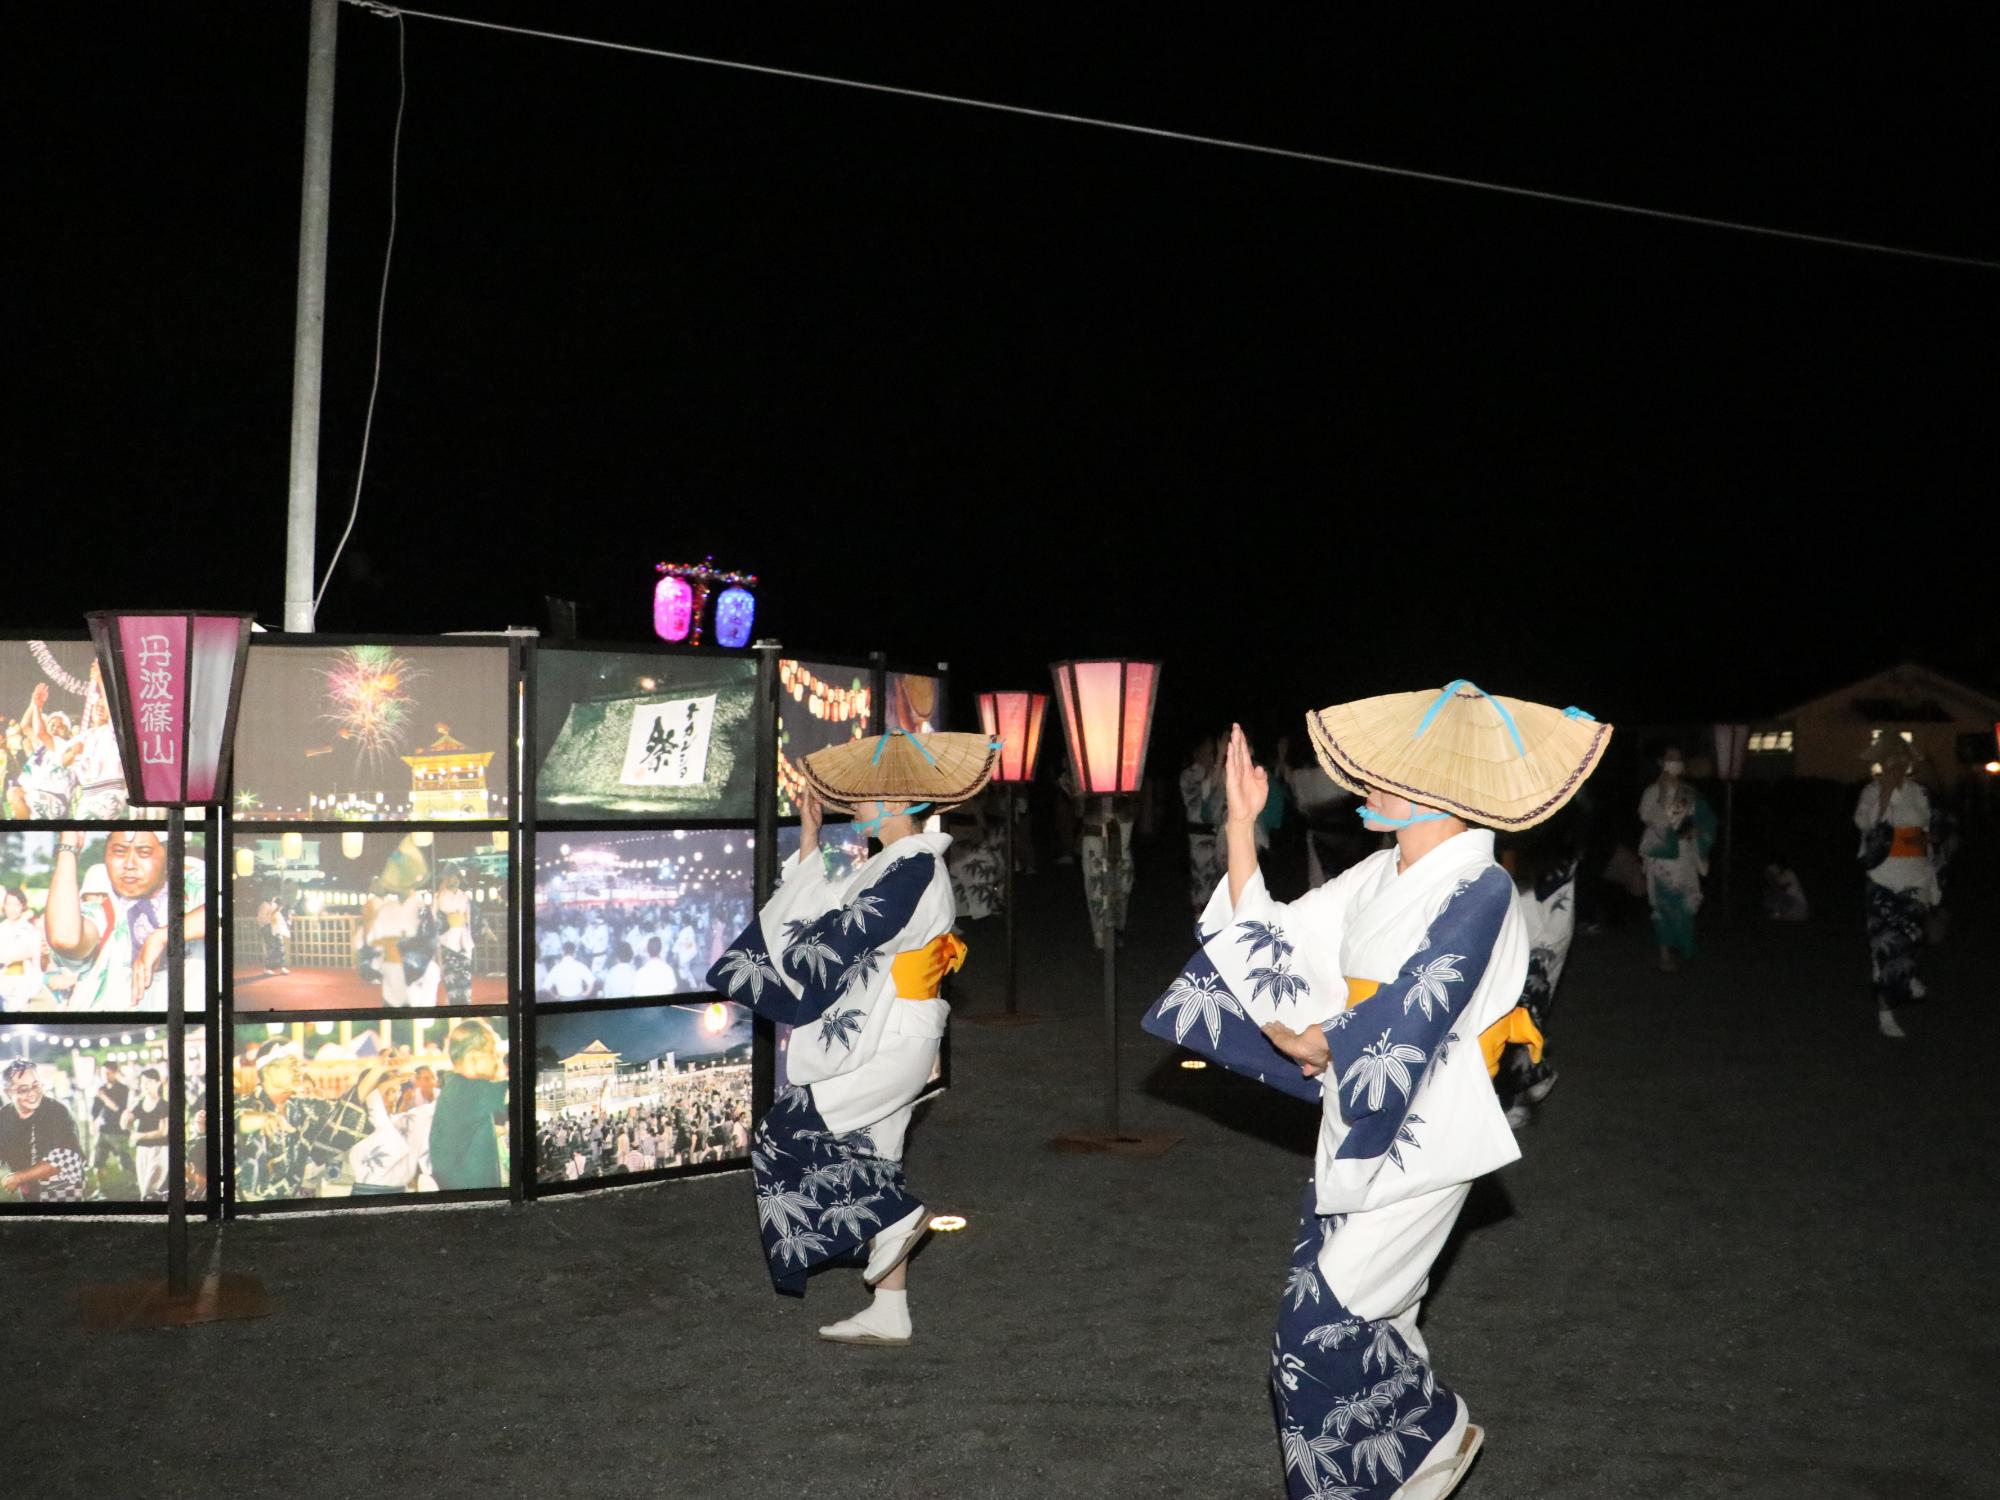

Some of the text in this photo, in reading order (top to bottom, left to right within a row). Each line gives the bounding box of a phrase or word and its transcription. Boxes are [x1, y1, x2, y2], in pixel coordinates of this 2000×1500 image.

[138, 634, 175, 765] 丹波篠山
[639, 715, 679, 774] 祭
